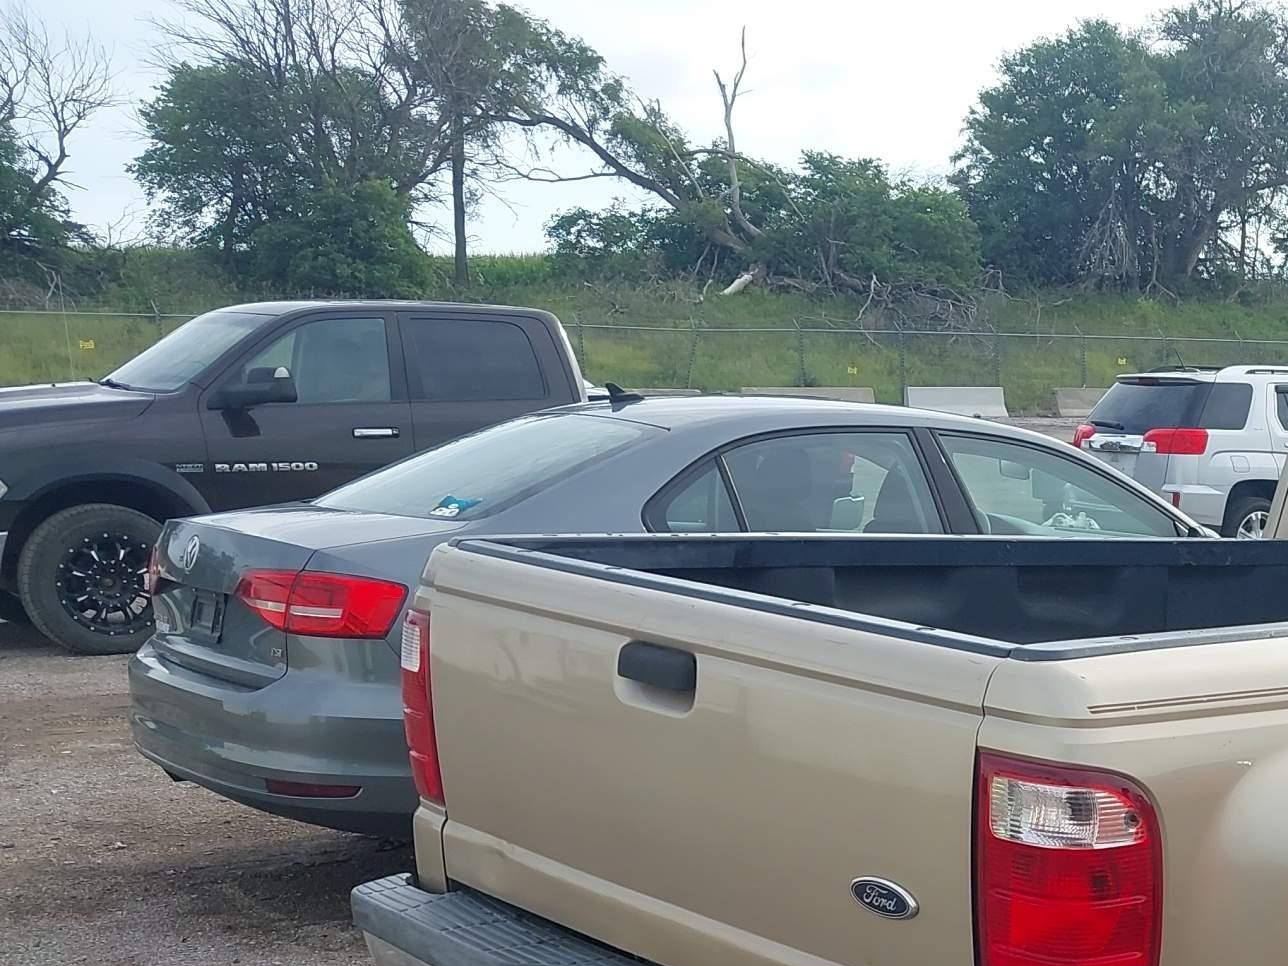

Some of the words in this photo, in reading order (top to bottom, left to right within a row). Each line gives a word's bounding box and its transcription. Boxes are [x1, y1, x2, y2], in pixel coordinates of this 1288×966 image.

[215, 463, 267, 473] RAM
[271, 462, 318, 471] 1500
[863, 884, 897, 911] Ford
